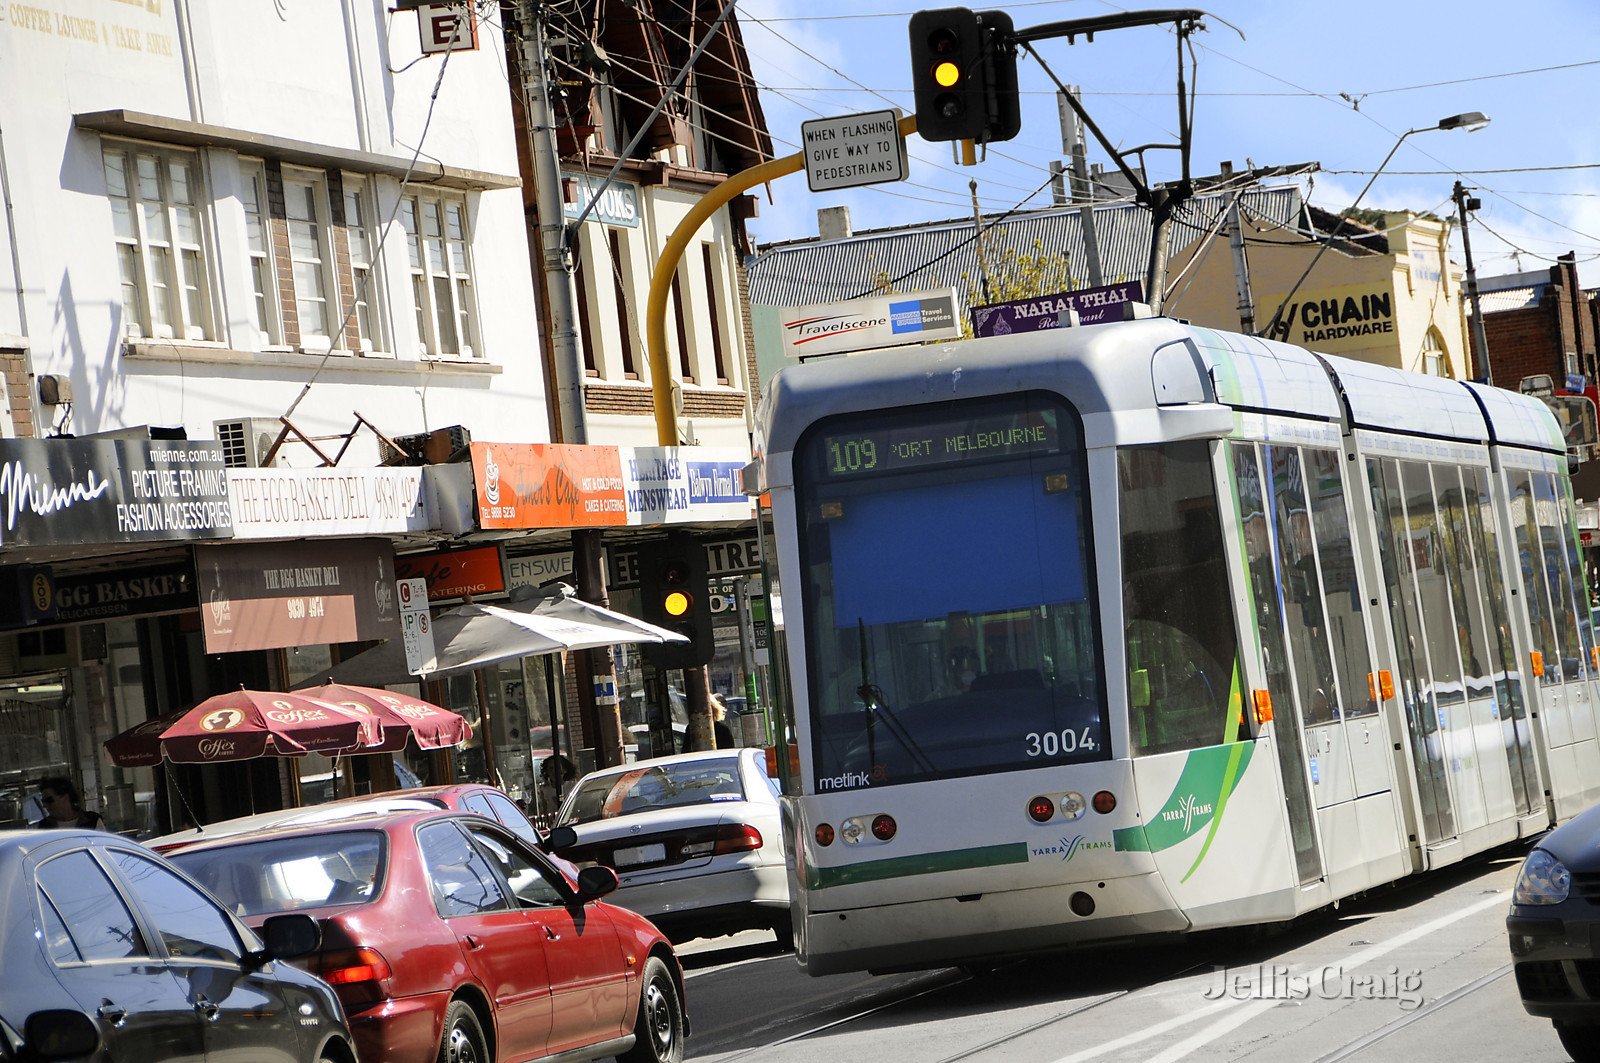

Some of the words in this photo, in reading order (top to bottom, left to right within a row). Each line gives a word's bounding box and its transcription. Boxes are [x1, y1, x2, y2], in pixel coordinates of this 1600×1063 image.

[10, 4, 51, 33] COFFEE
[55, 13, 98, 43] LOUNGE
[112, 24, 142, 51] TAKE
[147, 32, 173, 56] AWAY
[806, 128, 835, 142] WHEN
[842, 121, 893, 138] FLASHING
[814, 147, 839, 161] GIVE
[846, 143, 869, 157] WAY
[877, 141, 890, 152] TO
[816, 160, 893, 180] PEDESTRIANS
[921, 308, 942, 316] Travel
[1014, 298, 1076, 320] NARAI
[1080, 288, 1129, 309] THAI
[1301, 292, 1391, 328] CHAIN
[798, 315, 887, 335] Travelscene
[922, 315, 951, 323] Services
[1303, 321, 1393, 343] HARDWARE
[150, 446, 223, 463] mienne.com.au
[831, 439, 877, 472] 109
[945, 425, 1047, 453] MELBOURNE
[132, 470, 179, 498] PICTURE
[180, 469, 227, 497] FRAMING
[581, 477, 592, 490] HOT
[597, 477, 610, 490] COLD
[610, 477, 623, 490] FOOD
[0, 460, 109, 531] Mienne
[232, 478, 260, 523] THE
[260, 477, 290, 522] EGG
[289, 476, 338, 523] BASKET
[339, 476, 369, 520] DELI
[375, 476, 399, 519] 9830
[584, 500, 599, 512] CAKES
[604, 499, 624, 512] CATERING
[627, 488, 688, 512] MENSWEAR
[117, 503, 163, 532] FASHION
[164, 501, 231, 531] ACCESSORIES
[705, 541, 760, 573] TRE
[264, 569, 280, 589] THE
[281, 569, 296, 588] EGG
[297, 567, 323, 587] BASKET
[324, 566, 340, 586] DELI
[401, 584, 410, 602] C
[429, 583, 487, 599] ATERING
[722, 585, 734, 593] OF
[287, 599, 304, 619] 9830
[309, 597, 324, 617] 4974
[404, 615, 414, 630] 1P
[266, 709, 325, 724] Coffex
[391, 704, 432, 720] Coffex
[198, 738, 235, 760] Coffex
[1025, 726, 1095, 757] 3004
[819, 771, 870, 790] metlink
[1162, 811, 1184, 822] YARRA
[1192, 803, 1212, 815] TRAMS
[1032, 846, 1065, 856] YARRA
[1080, 841, 1112, 851] TRAMS
